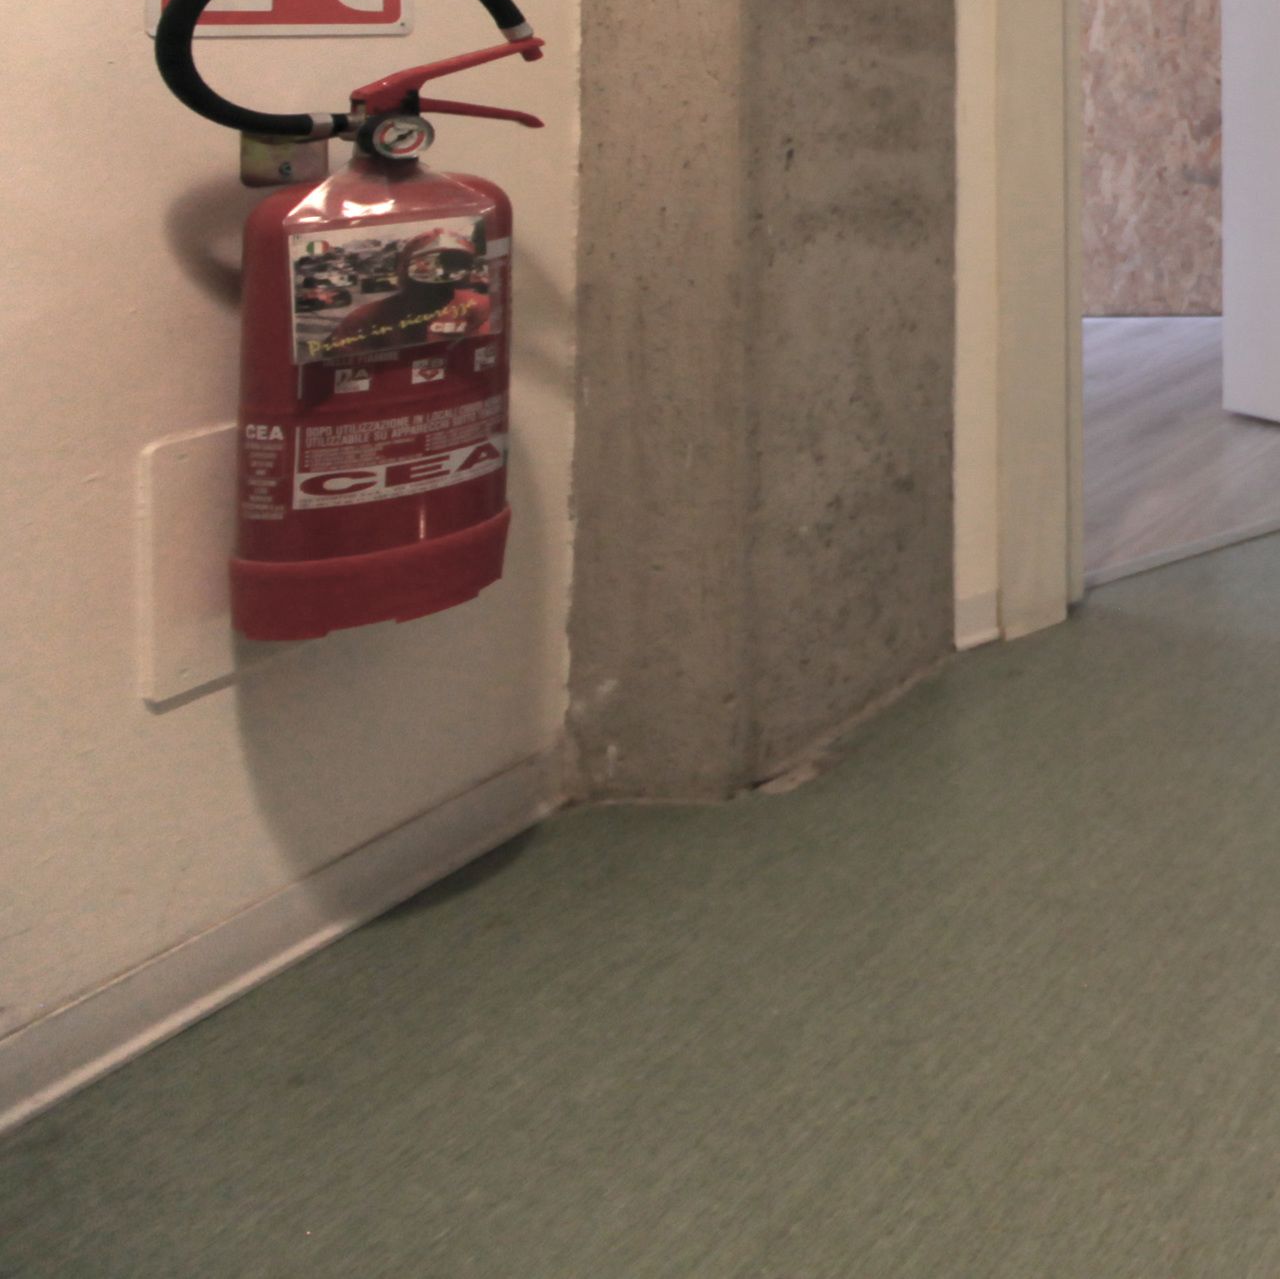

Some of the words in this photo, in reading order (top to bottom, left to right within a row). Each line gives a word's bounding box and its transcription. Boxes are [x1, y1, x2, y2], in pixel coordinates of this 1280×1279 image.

[430, 320, 467, 334] CEA
[246, 424, 284, 441] CEA
[374, 430, 388, 441] SU
[300, 442, 500, 496] CEA
